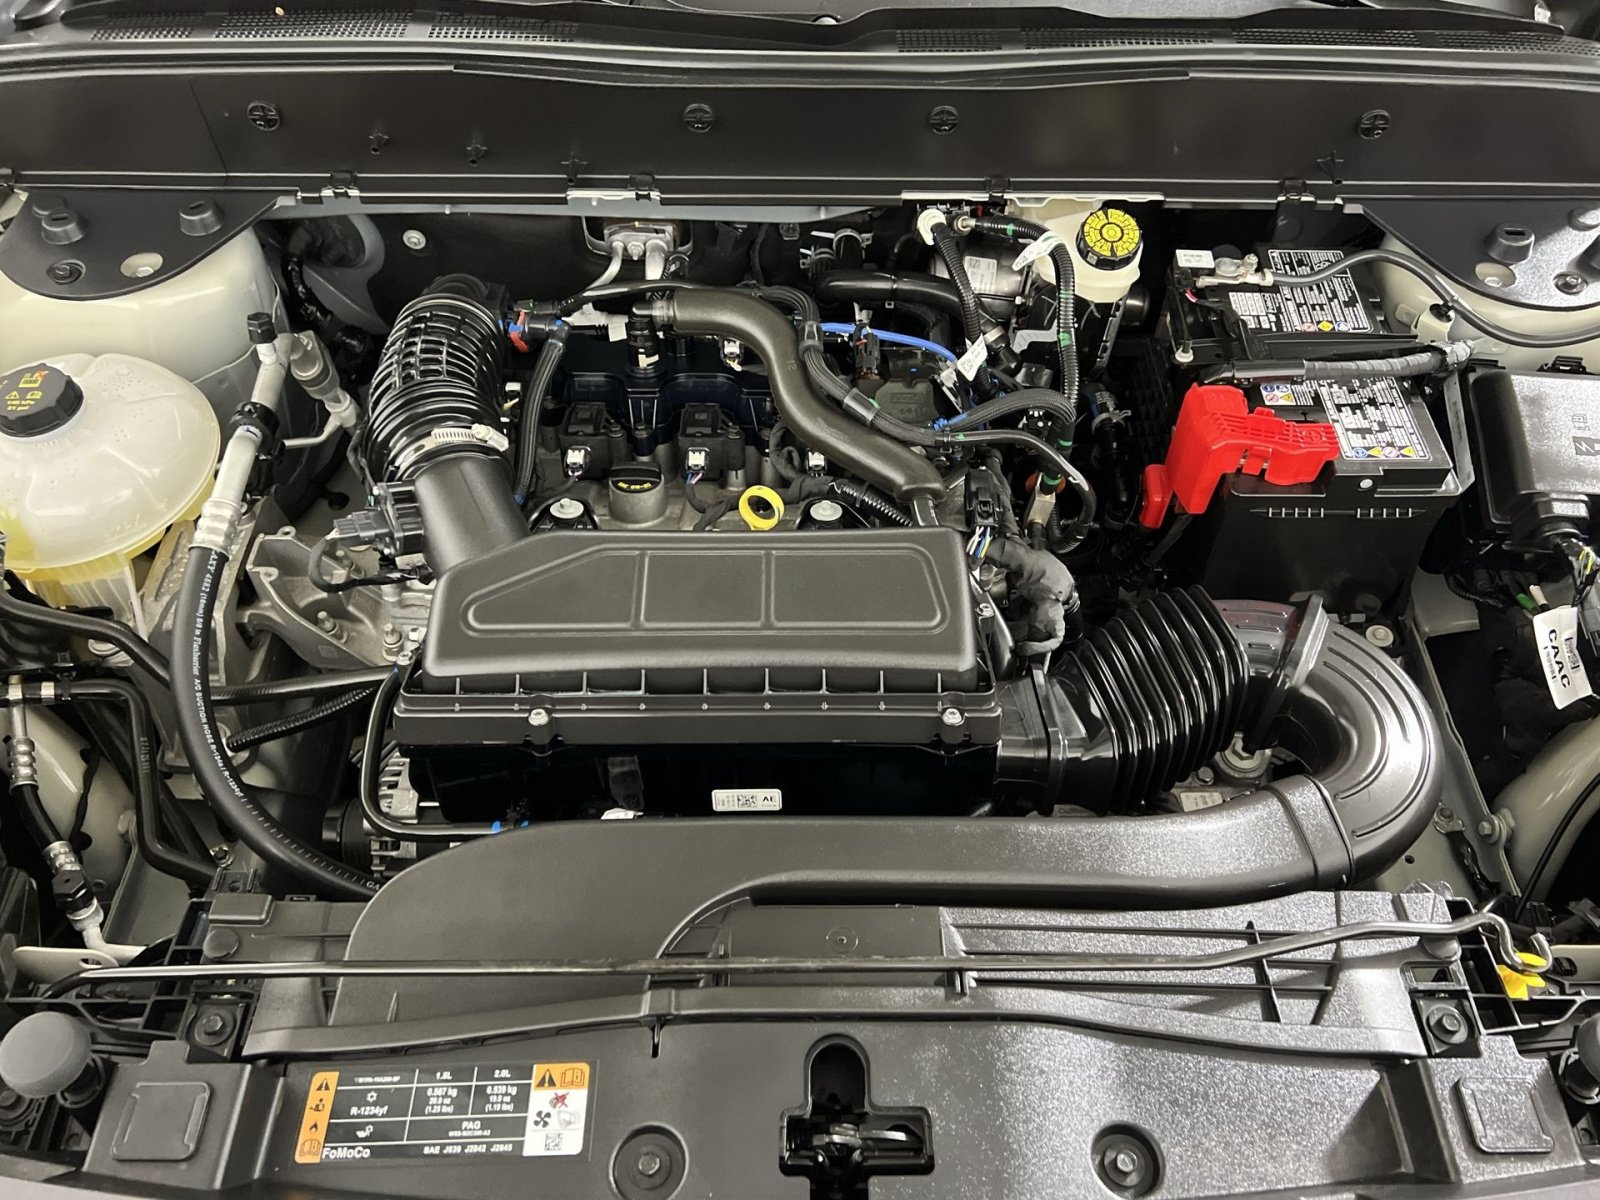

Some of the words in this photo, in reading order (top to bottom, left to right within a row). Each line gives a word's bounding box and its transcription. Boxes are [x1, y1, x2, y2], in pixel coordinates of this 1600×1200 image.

[1548, 628, 1571, 688] CAAC
[195, 691, 209, 724] SUCTION
[202, 723, 215, 744] HOSE
[435, 1071, 453, 1080] 1.5L
[493, 1069, 511, 1078] 2.0L
[447, 1087, 458, 1098] kg
[507, 1085, 518, 1097] kg
[350, 1105, 389, 1117] R-1234yf
[461, 1120, 481, 1130] PAG
[322, 1146, 371, 1159] FoMoCo
[423, 1145, 441, 1155] SAE
[443, 1145, 462, 1155] J639
